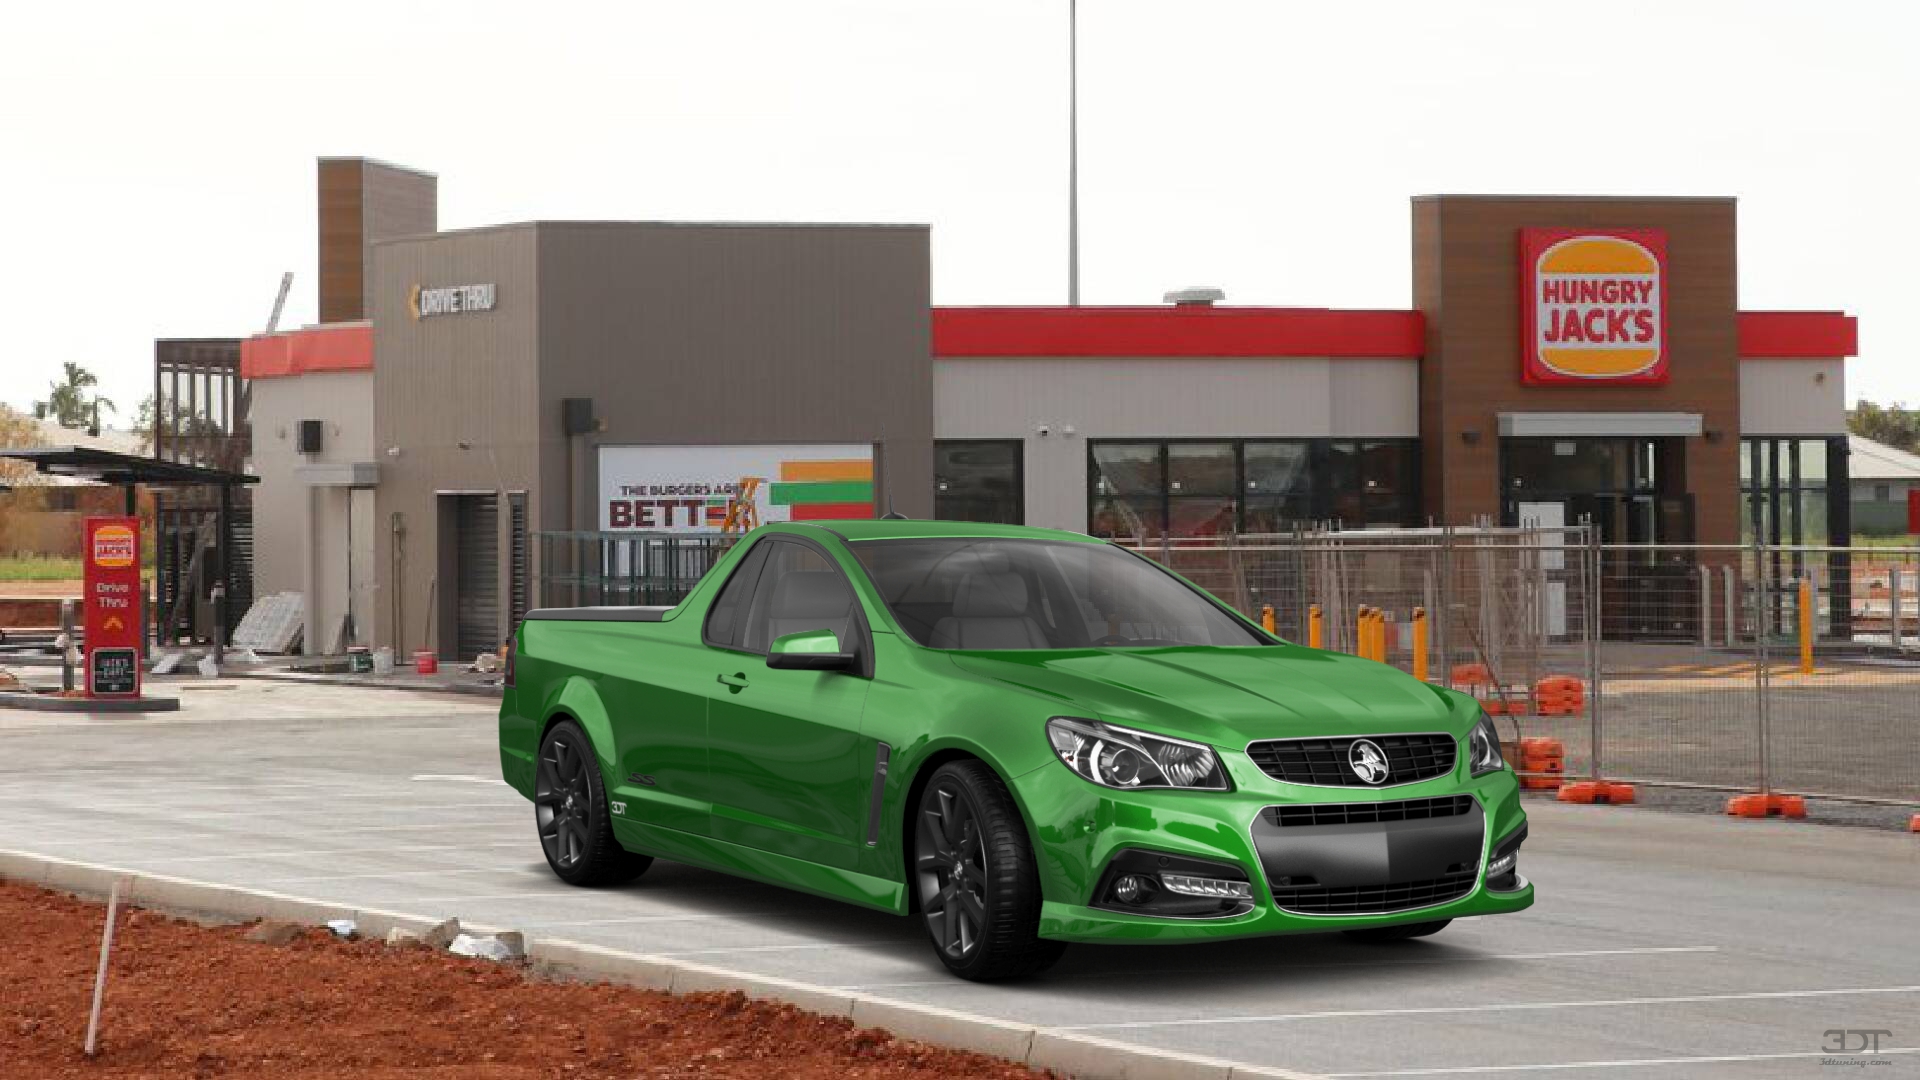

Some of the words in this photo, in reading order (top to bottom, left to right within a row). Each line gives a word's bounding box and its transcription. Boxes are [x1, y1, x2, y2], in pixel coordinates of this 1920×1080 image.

[421, 287, 460, 315] DRIVE
[459, 283, 496, 311] THRU
[1543, 280, 1653, 304] HUNGRY
[1544, 308, 1655, 343] JACK'S
[620, 484, 647, 496] THE
[649, 483, 710, 496] BURGERS
[96, 582, 128, 593] Drive
[99, 596, 128, 608] Thru
[627, 772, 656, 786] SS
